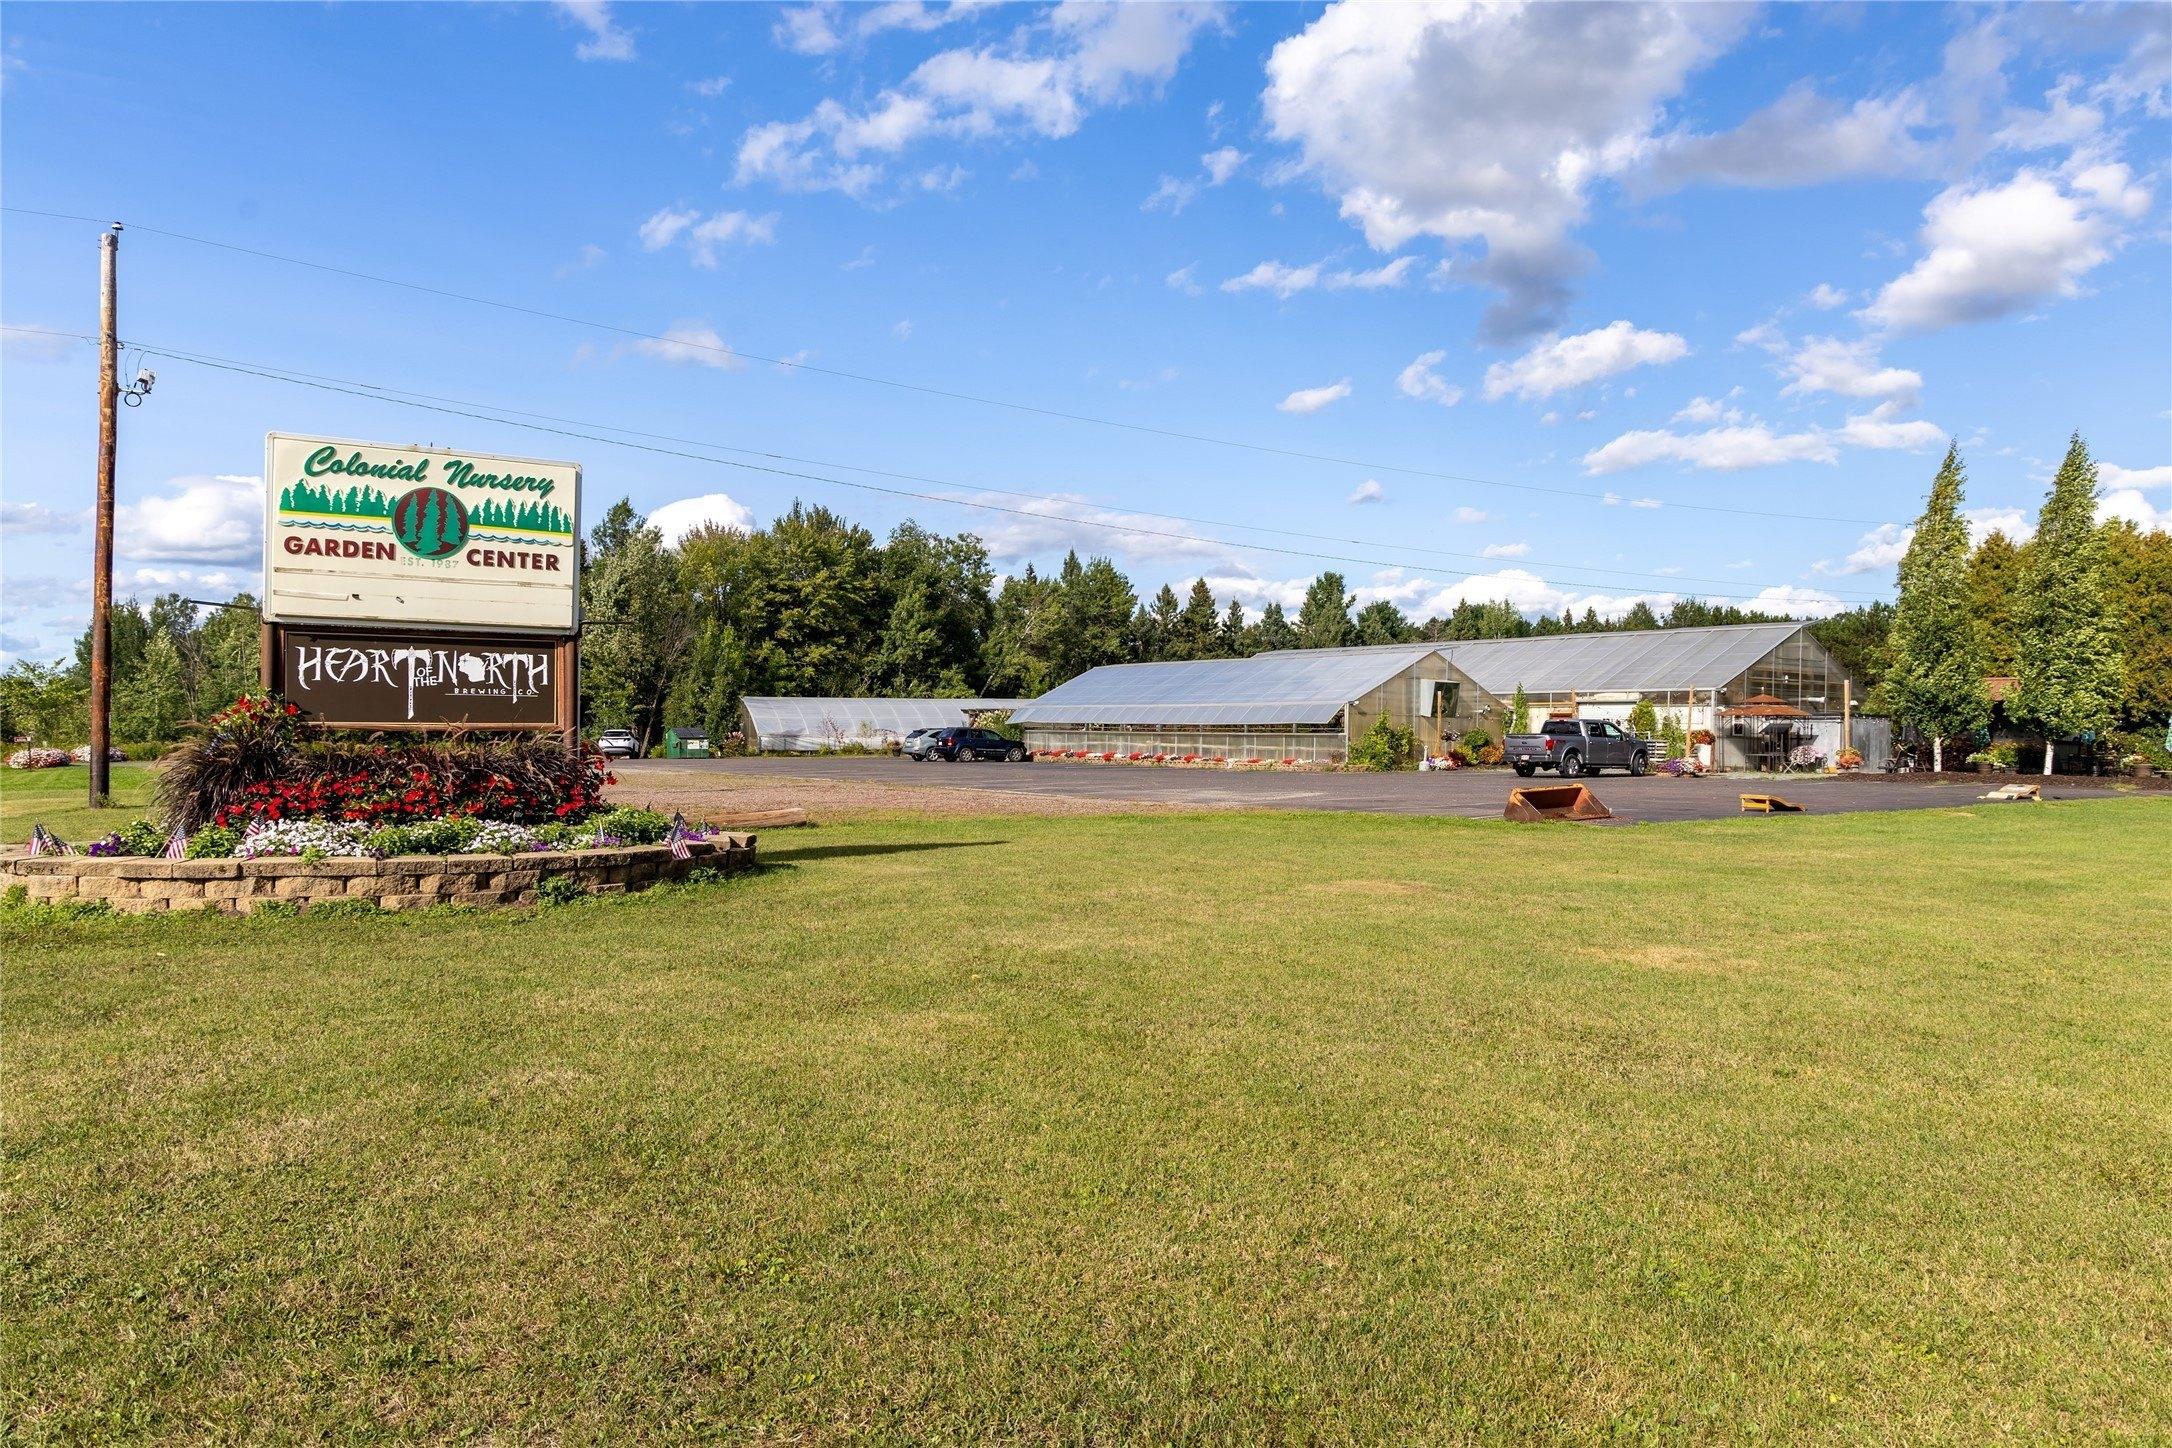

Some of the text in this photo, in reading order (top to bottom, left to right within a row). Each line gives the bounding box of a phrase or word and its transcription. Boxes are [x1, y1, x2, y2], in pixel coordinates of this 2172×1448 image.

[304, 445, 555, 499] Colonial Nursery
[283, 535, 560, 571] GARDEN CENTER
[416, 667, 433, 677] OF
[414, 676, 438, 687] THE
[454, 687, 506, 695] BREWING
